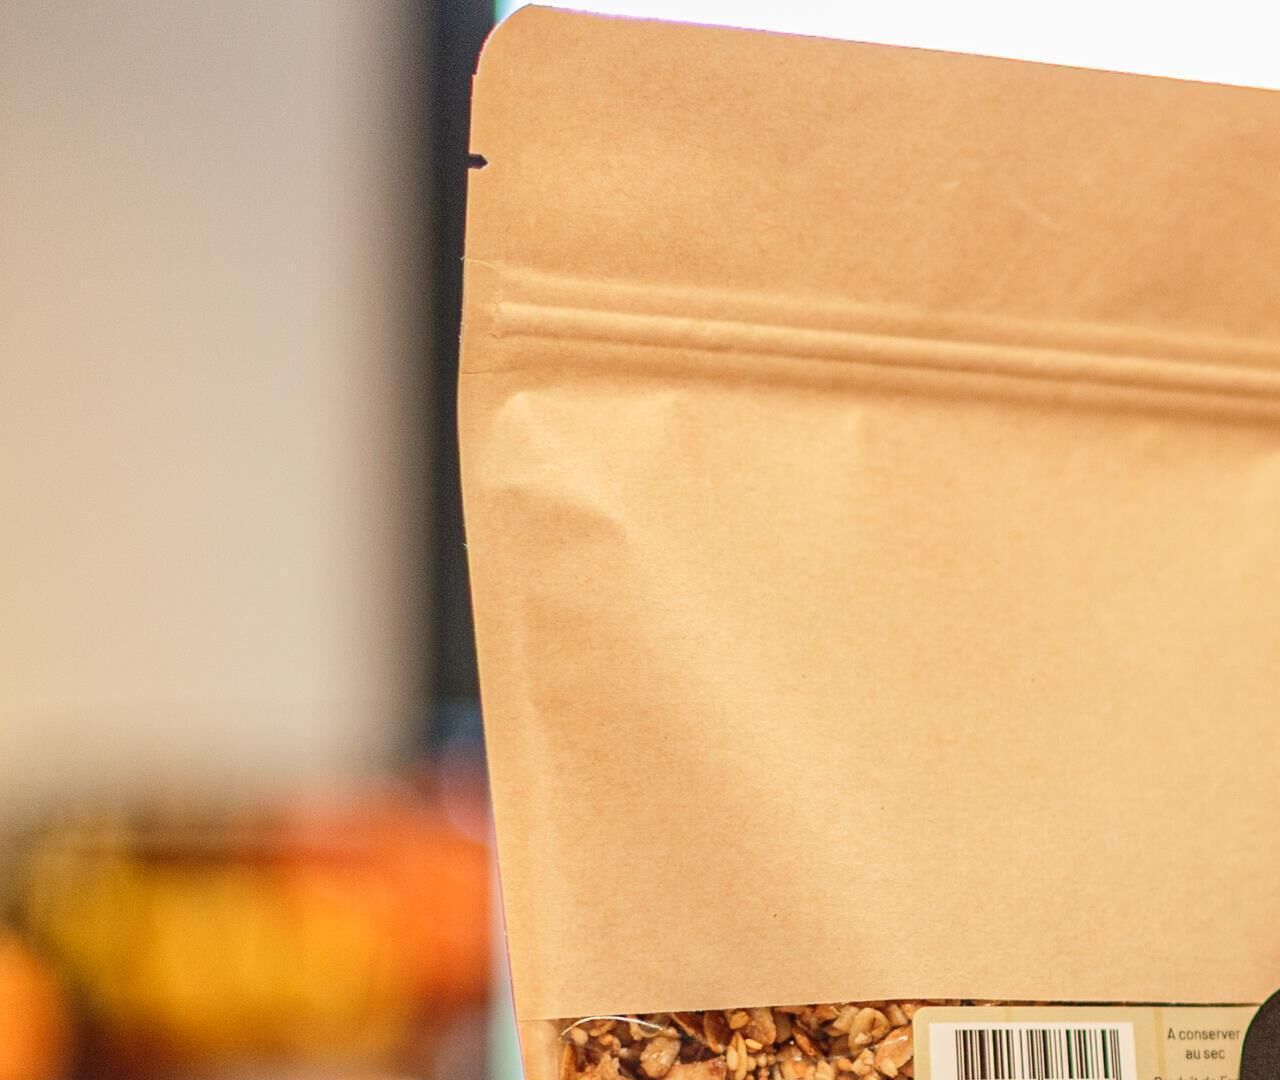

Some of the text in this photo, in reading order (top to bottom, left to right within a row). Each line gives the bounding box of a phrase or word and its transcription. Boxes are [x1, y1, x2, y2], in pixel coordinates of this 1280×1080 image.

[1179, 1029, 1241, 1040] conserver
[1185, 1049, 1226, 1060] au sec
